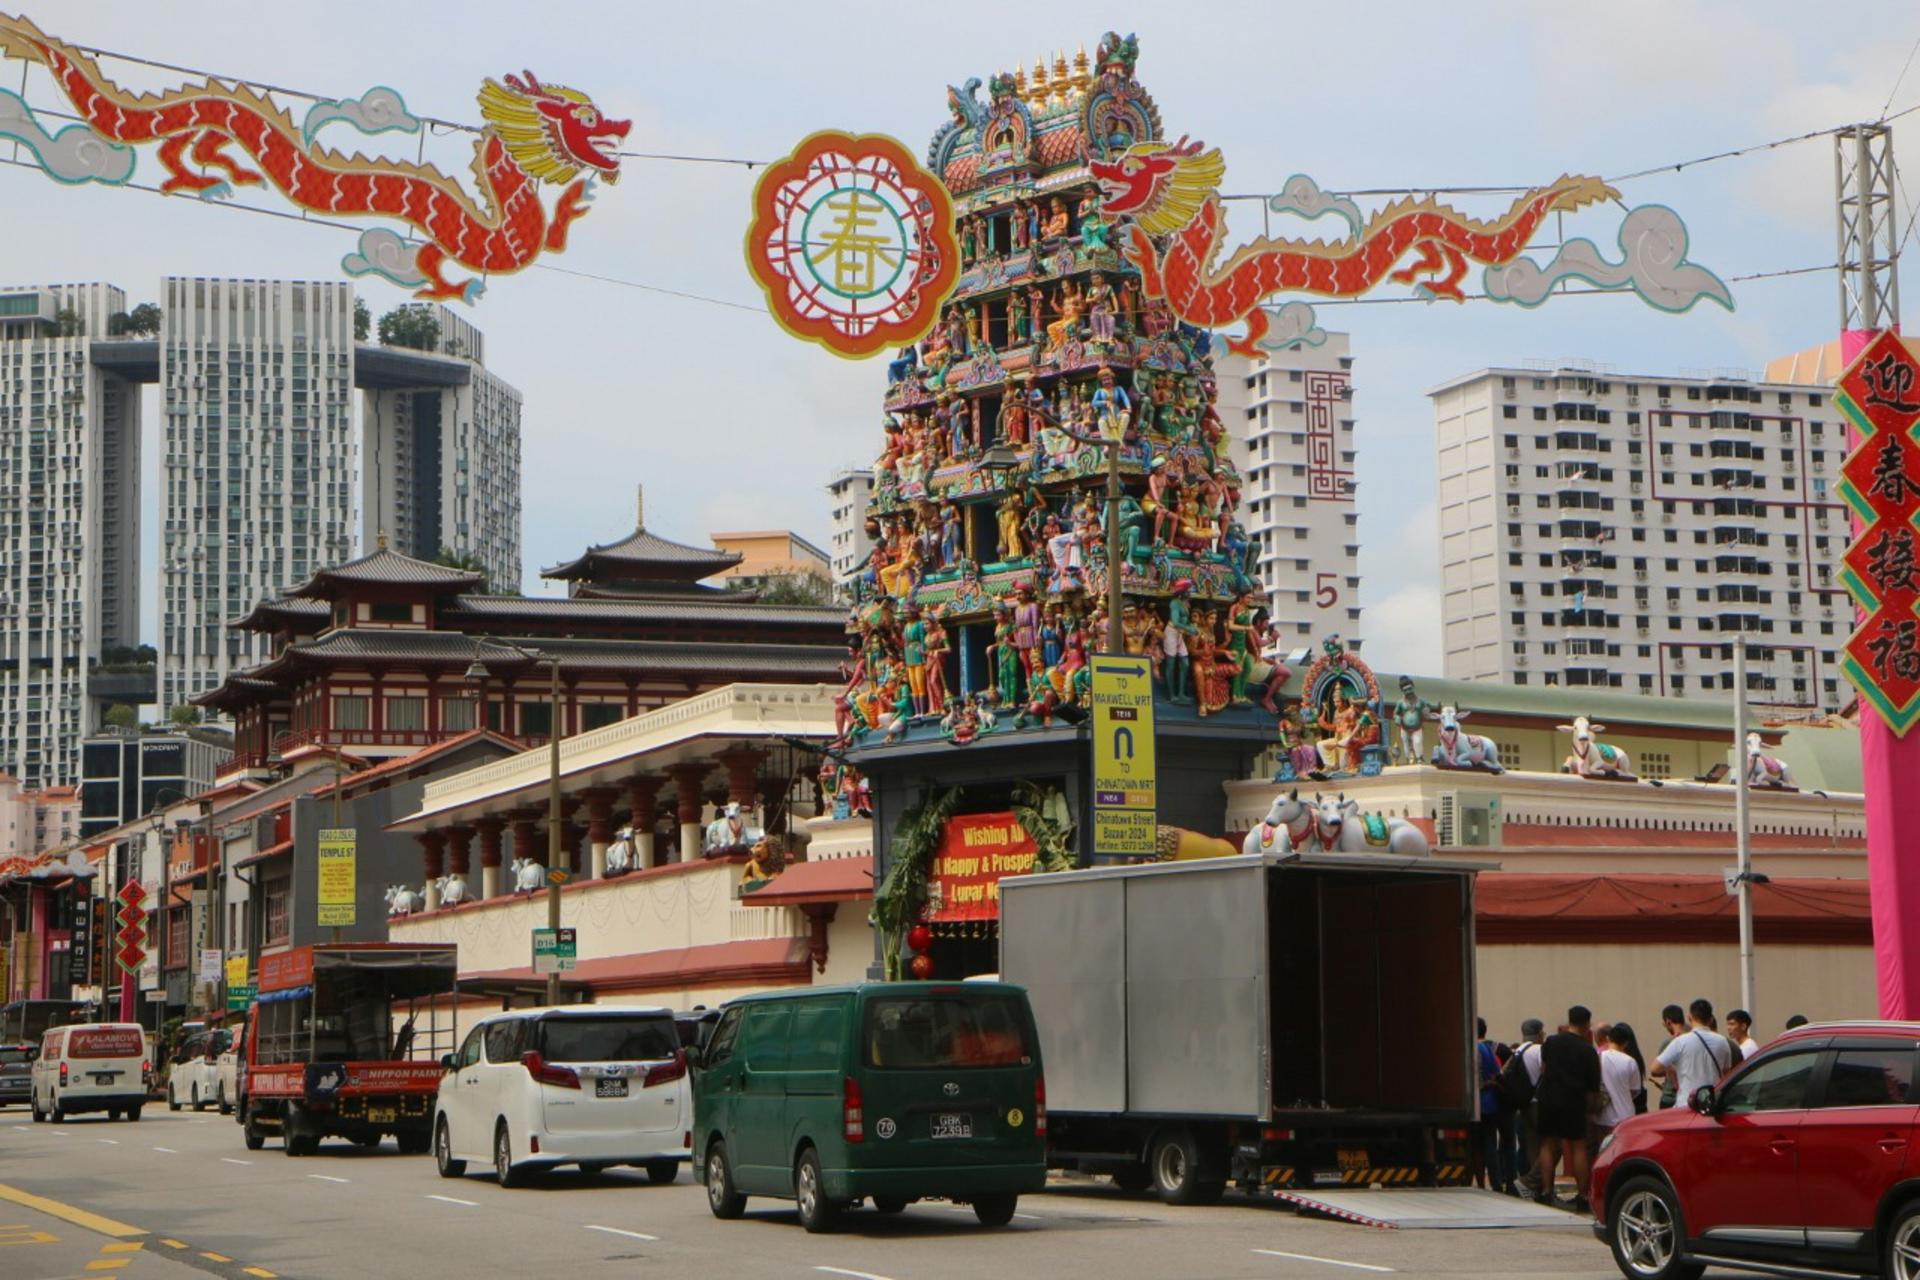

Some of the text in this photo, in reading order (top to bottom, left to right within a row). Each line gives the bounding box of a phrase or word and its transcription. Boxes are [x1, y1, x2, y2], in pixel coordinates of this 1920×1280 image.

[811, 190, 899, 292] 春
[1860, 351, 1920, 682] 迎春接福
[1316, 572, 1338, 609] 5
[1116, 677, 1128, 689] TO
[1095, 693, 1151, 706] MAXWELL MRT
[1119, 762, 1130, 774] TO
[1096, 778, 1154, 790] CHINATOWN MRT
[1096, 812, 1154, 826] Chinatown Street
[963, 825, 1009, 848] Wishing
[320, 848, 345, 858] TEMPLE
[933, 853, 1036, 877] A Happy & Prosper
[952, 882, 999, 902] Lunar Ne
[557, 959, 565, 970] 4
[368, 1069, 444, 1079] NIPPON PAINT
[939, 1115, 961, 1126] GBK
